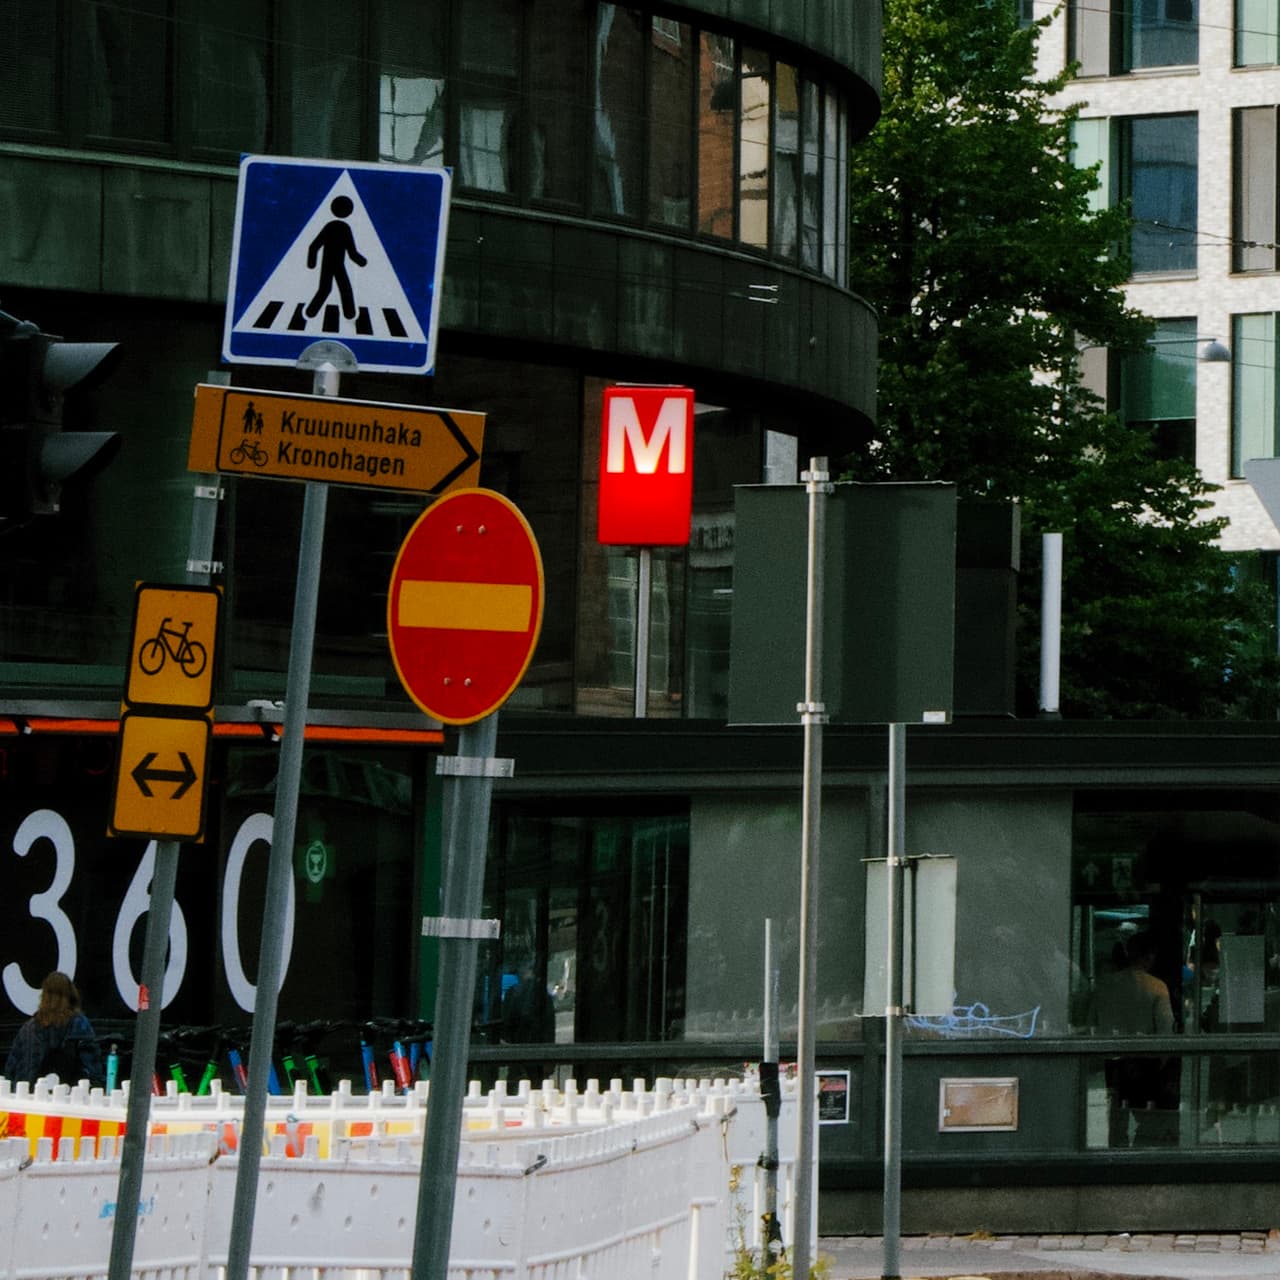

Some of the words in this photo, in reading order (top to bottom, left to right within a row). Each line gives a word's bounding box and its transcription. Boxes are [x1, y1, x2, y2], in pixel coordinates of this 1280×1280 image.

[280, 410, 422, 448] Kruununhaka
[606, 396, 687, 474] M
[277, 441, 405, 477] Kronohagen
[2, 808, 296, 1017] 360
